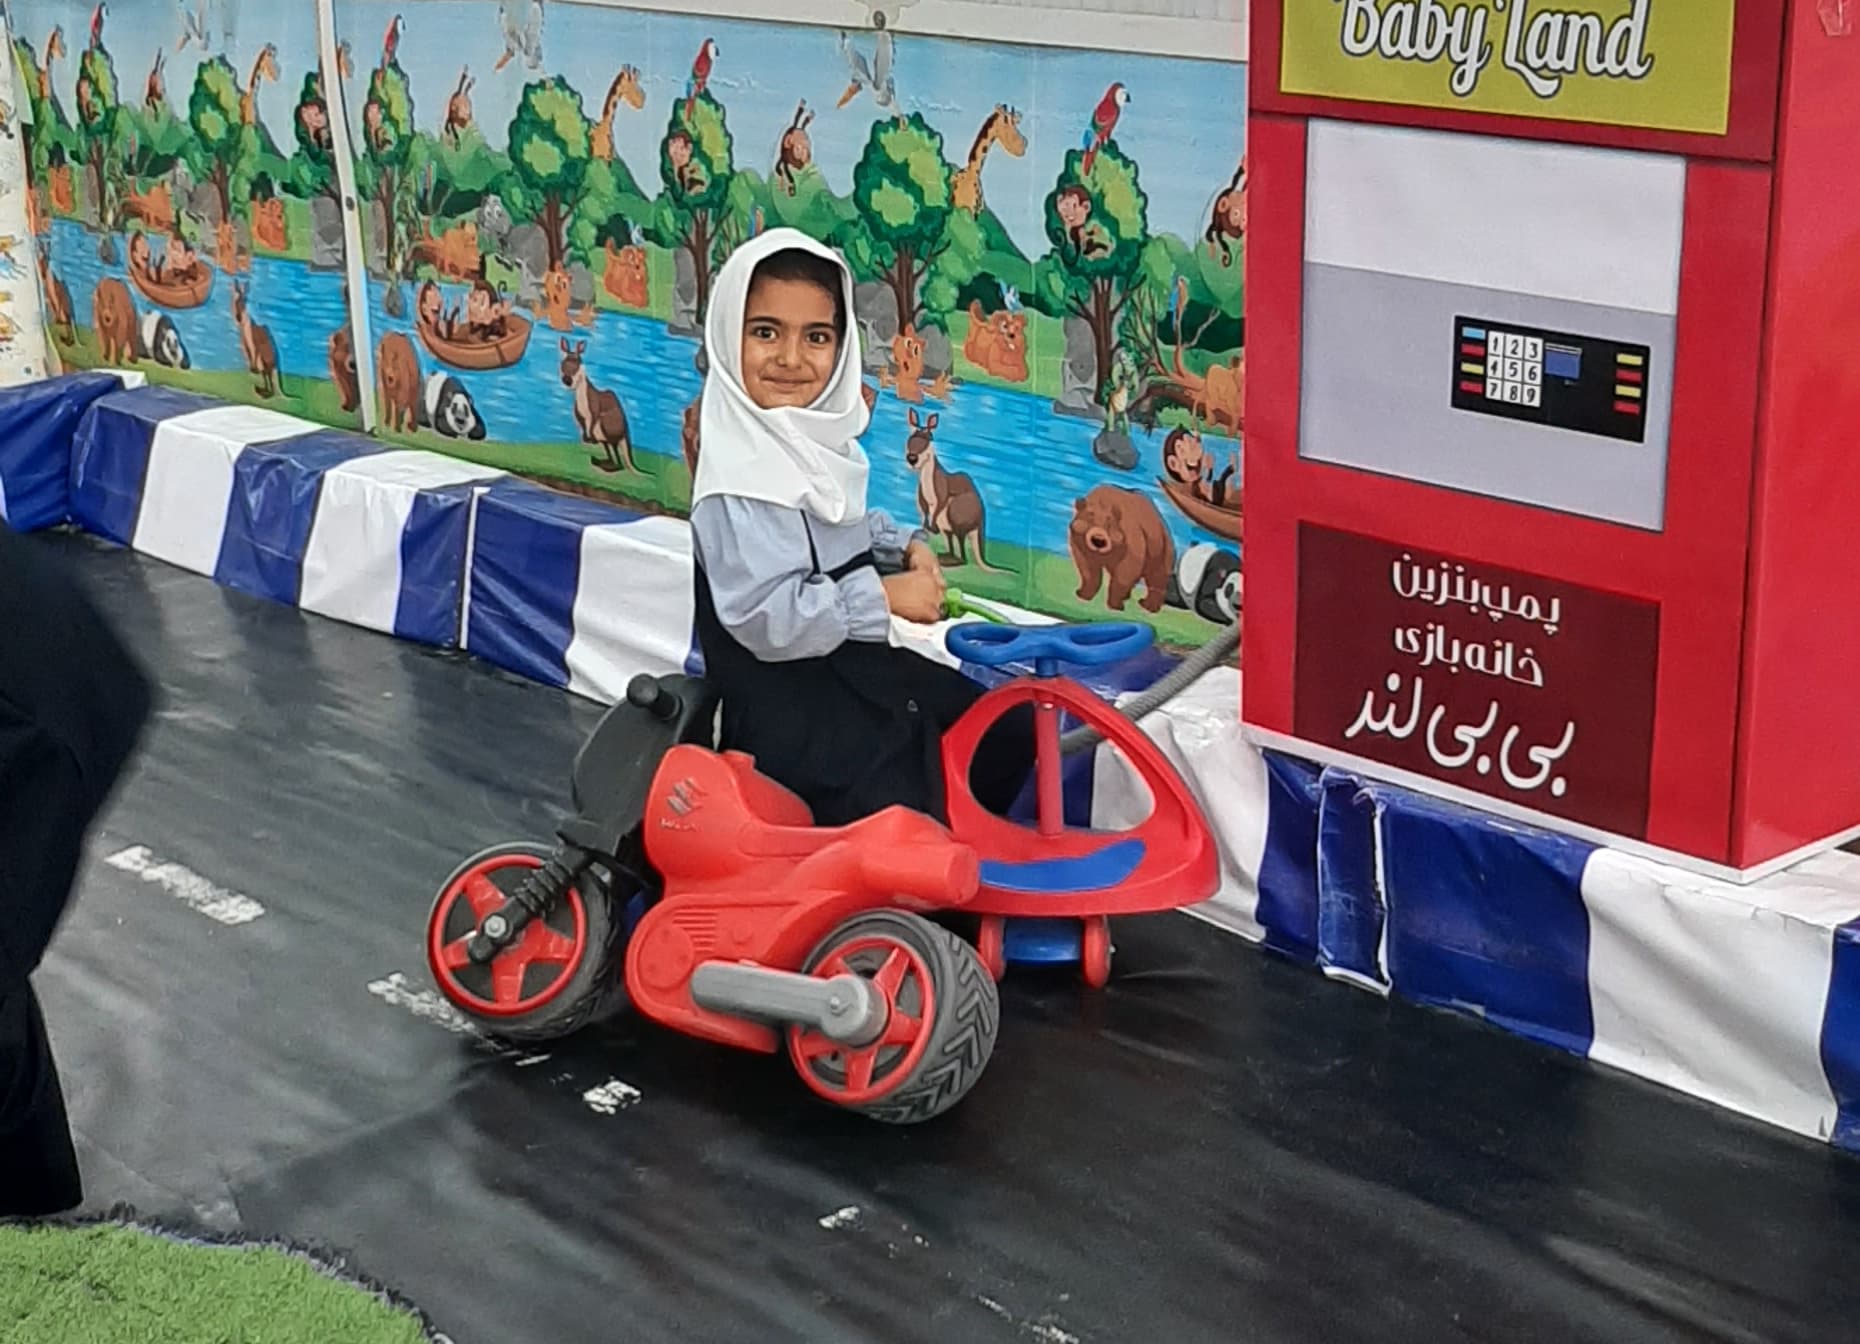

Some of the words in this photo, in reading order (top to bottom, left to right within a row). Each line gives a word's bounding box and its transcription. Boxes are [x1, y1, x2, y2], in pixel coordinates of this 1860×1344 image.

[1490, 359, 1498, 376] 4
[1508, 361, 1518, 378] 5
[1528, 365, 1538, 382] 6
[1492, 336, 1499, 353] 1
[1510, 338, 1519, 356] 2
[1528, 341, 1538, 359] 3
[1489, 382, 1498, 397] 7
[1509, 385, 1518, 401] 8
[1526, 387, 1536, 404] 9
[1392, 553, 1480, 614] بنزین
[1482, 584, 1560, 636] پمپ
[1395, 622, 1461, 674] بازی
[1464, 639, 1544, 688] خانه
[1344, 672, 1423, 739] لند
[1426, 700, 1499, 775] بی
[1500, 721, 1575, 797] بی
